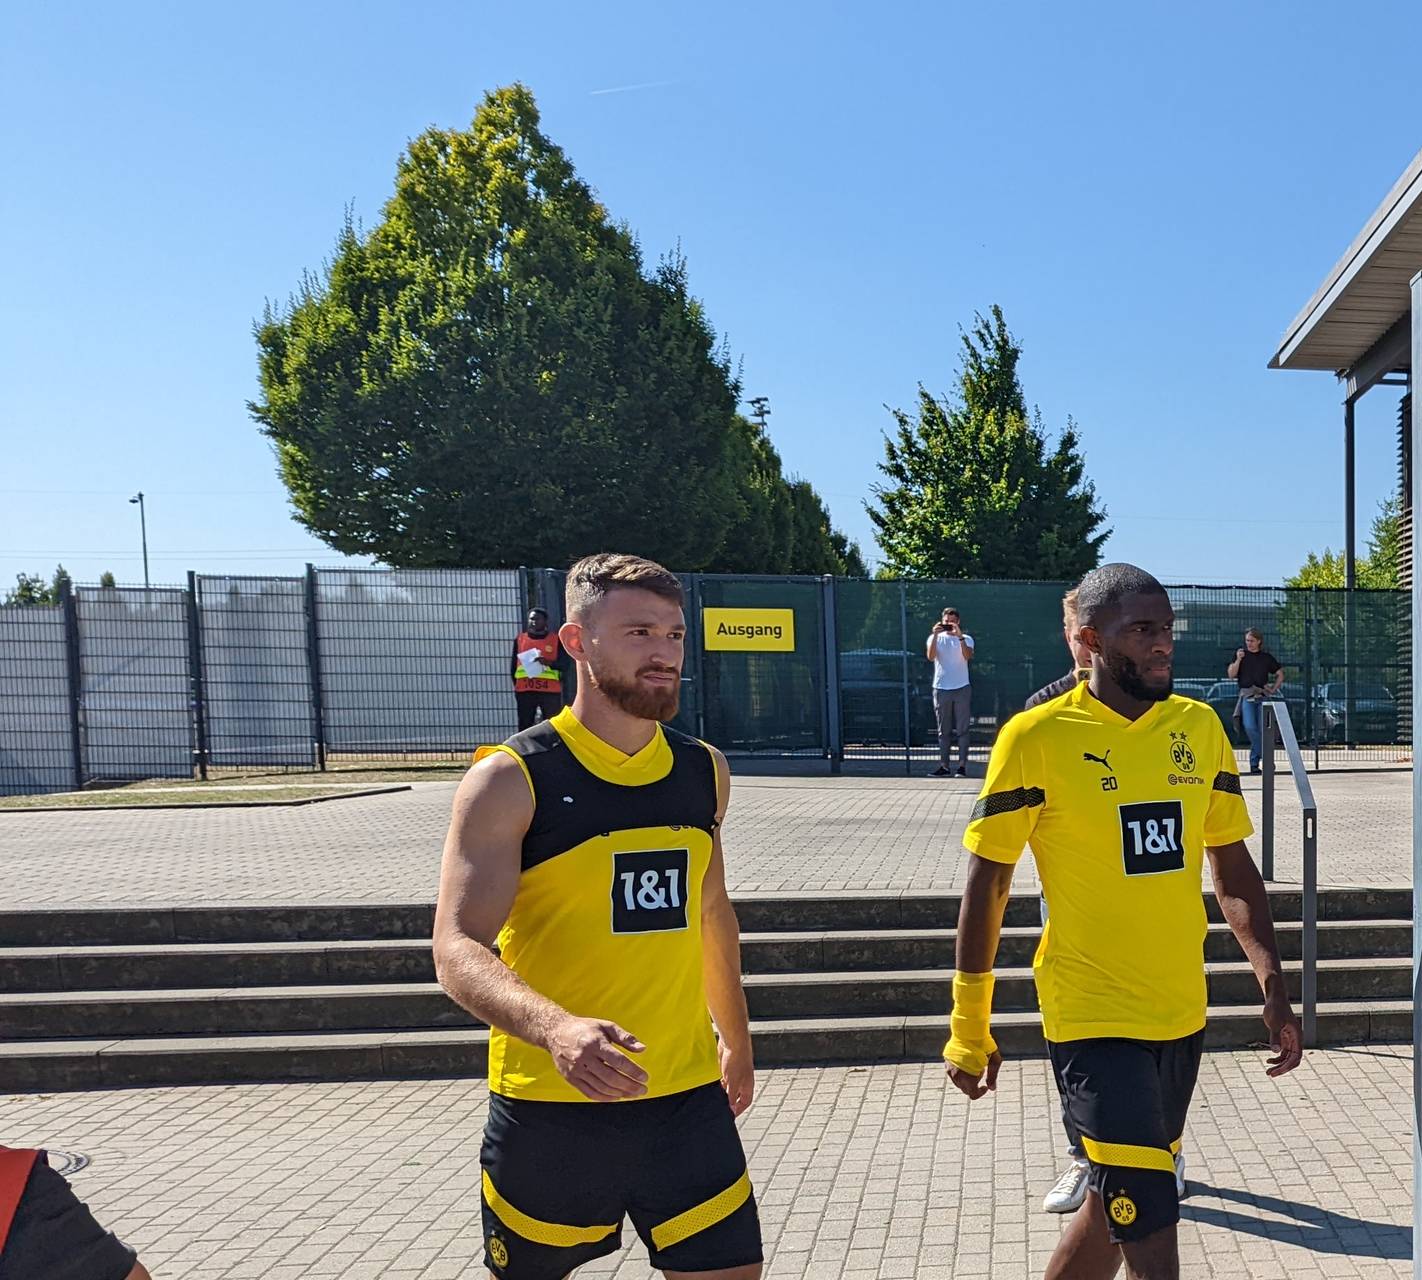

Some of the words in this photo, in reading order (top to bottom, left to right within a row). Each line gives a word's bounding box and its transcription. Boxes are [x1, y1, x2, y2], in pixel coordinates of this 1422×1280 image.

[717, 622, 782, 639] Ausgang
[1173, 744, 1194, 765] BVB
[1101, 776, 1118, 791] 20
[1127, 818, 1178, 856] 1&1
[620, 868, 681, 911] 1&1
[1113, 1200, 1134, 1218] BVB
